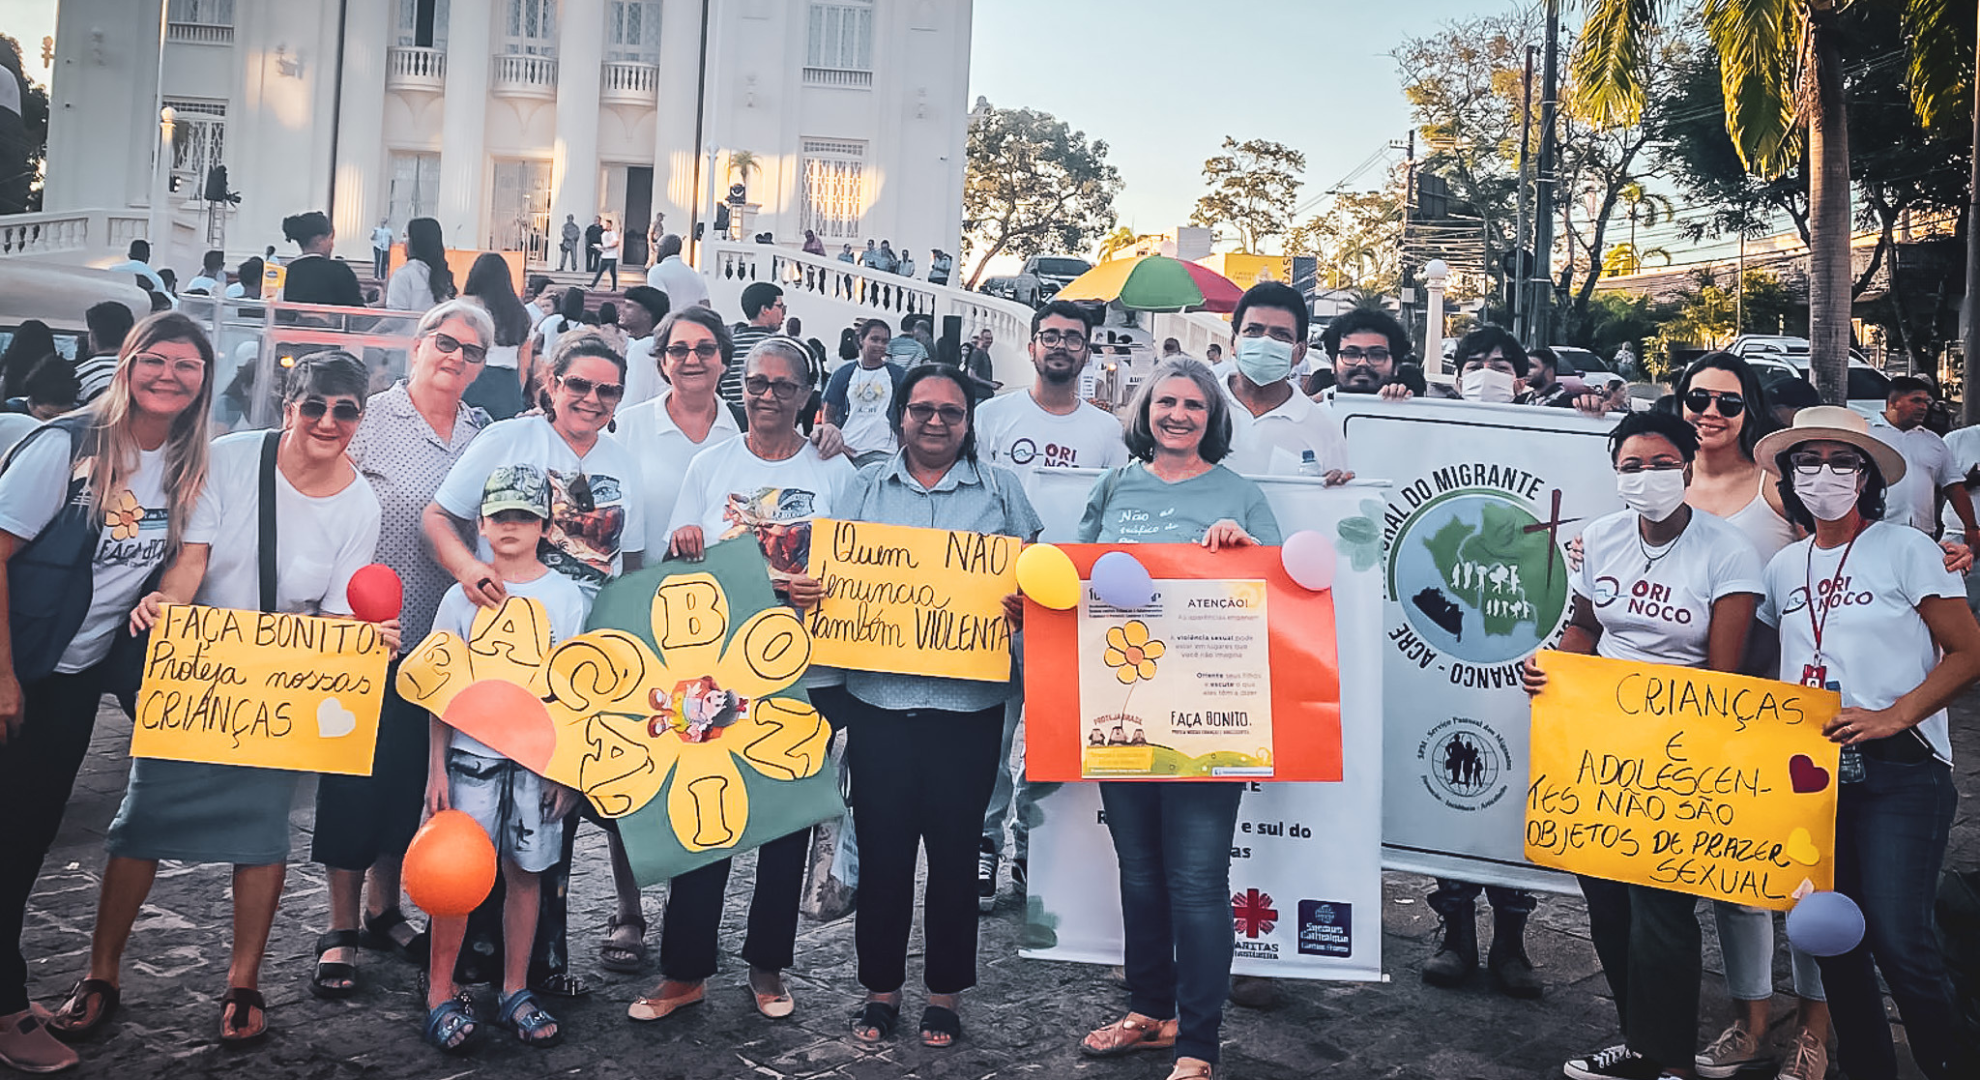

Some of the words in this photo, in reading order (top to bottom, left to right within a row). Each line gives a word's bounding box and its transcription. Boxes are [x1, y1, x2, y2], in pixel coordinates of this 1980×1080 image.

[1045, 443, 1077, 462] ORI
[1400, 478, 1433, 509] DO
[1432, 463, 1545, 501] MIGRANTE
[1118, 509, 1149, 523] Não
[834, 521, 919, 569] Quem
[945, 531, 1008, 576] NÃO
[817, 560, 951, 609] denuncia
[1187, 597, 1249, 609] ATENÇÃO!
[1632, 579, 1671, 603] ORI
[1817, 576, 1852, 596] ORI
[1817, 591, 1874, 612] NOCO
[163, 604, 243, 650] FAÇA
[254, 612, 387, 656] BONITO!
[808, 598, 905, 648] também
[916, 607, 1013, 655] VIOLENTA
[1627, 598, 1692, 624] NOCO
[1388, 622, 1438, 669] ACRE
[147, 641, 247, 695] Proteja
[266, 669, 371, 696] nossas
[142, 690, 292, 749] CRIANÇAS
[1171, 710, 1202, 728] FAÇA
[1206, 710, 1252, 727] BONITO.
[1616, 673, 1804, 732] CRIANÇAS
[1665, 731, 1688, 761] E
[1577, 749, 1772, 798] ADOLESCEN-
[1527, 774, 1580, 815] TES
[1597, 787, 1665, 821] NÃO
[1675, 796, 1734, 826] SÃO
[1241, 822, 1252, 833] e
[1257, 821, 1283, 837] sul
[1289, 823, 1312, 838] do
[1526, 819, 1640, 857] OBJETOS
[1652, 830, 1684, 856] DE
[1692, 830, 1792, 868] PRAZER
[1230, 846, 1252, 859] as
[1649, 858, 1787, 899] SEXUAL
[1234, 941, 1279, 953] ARITAS
